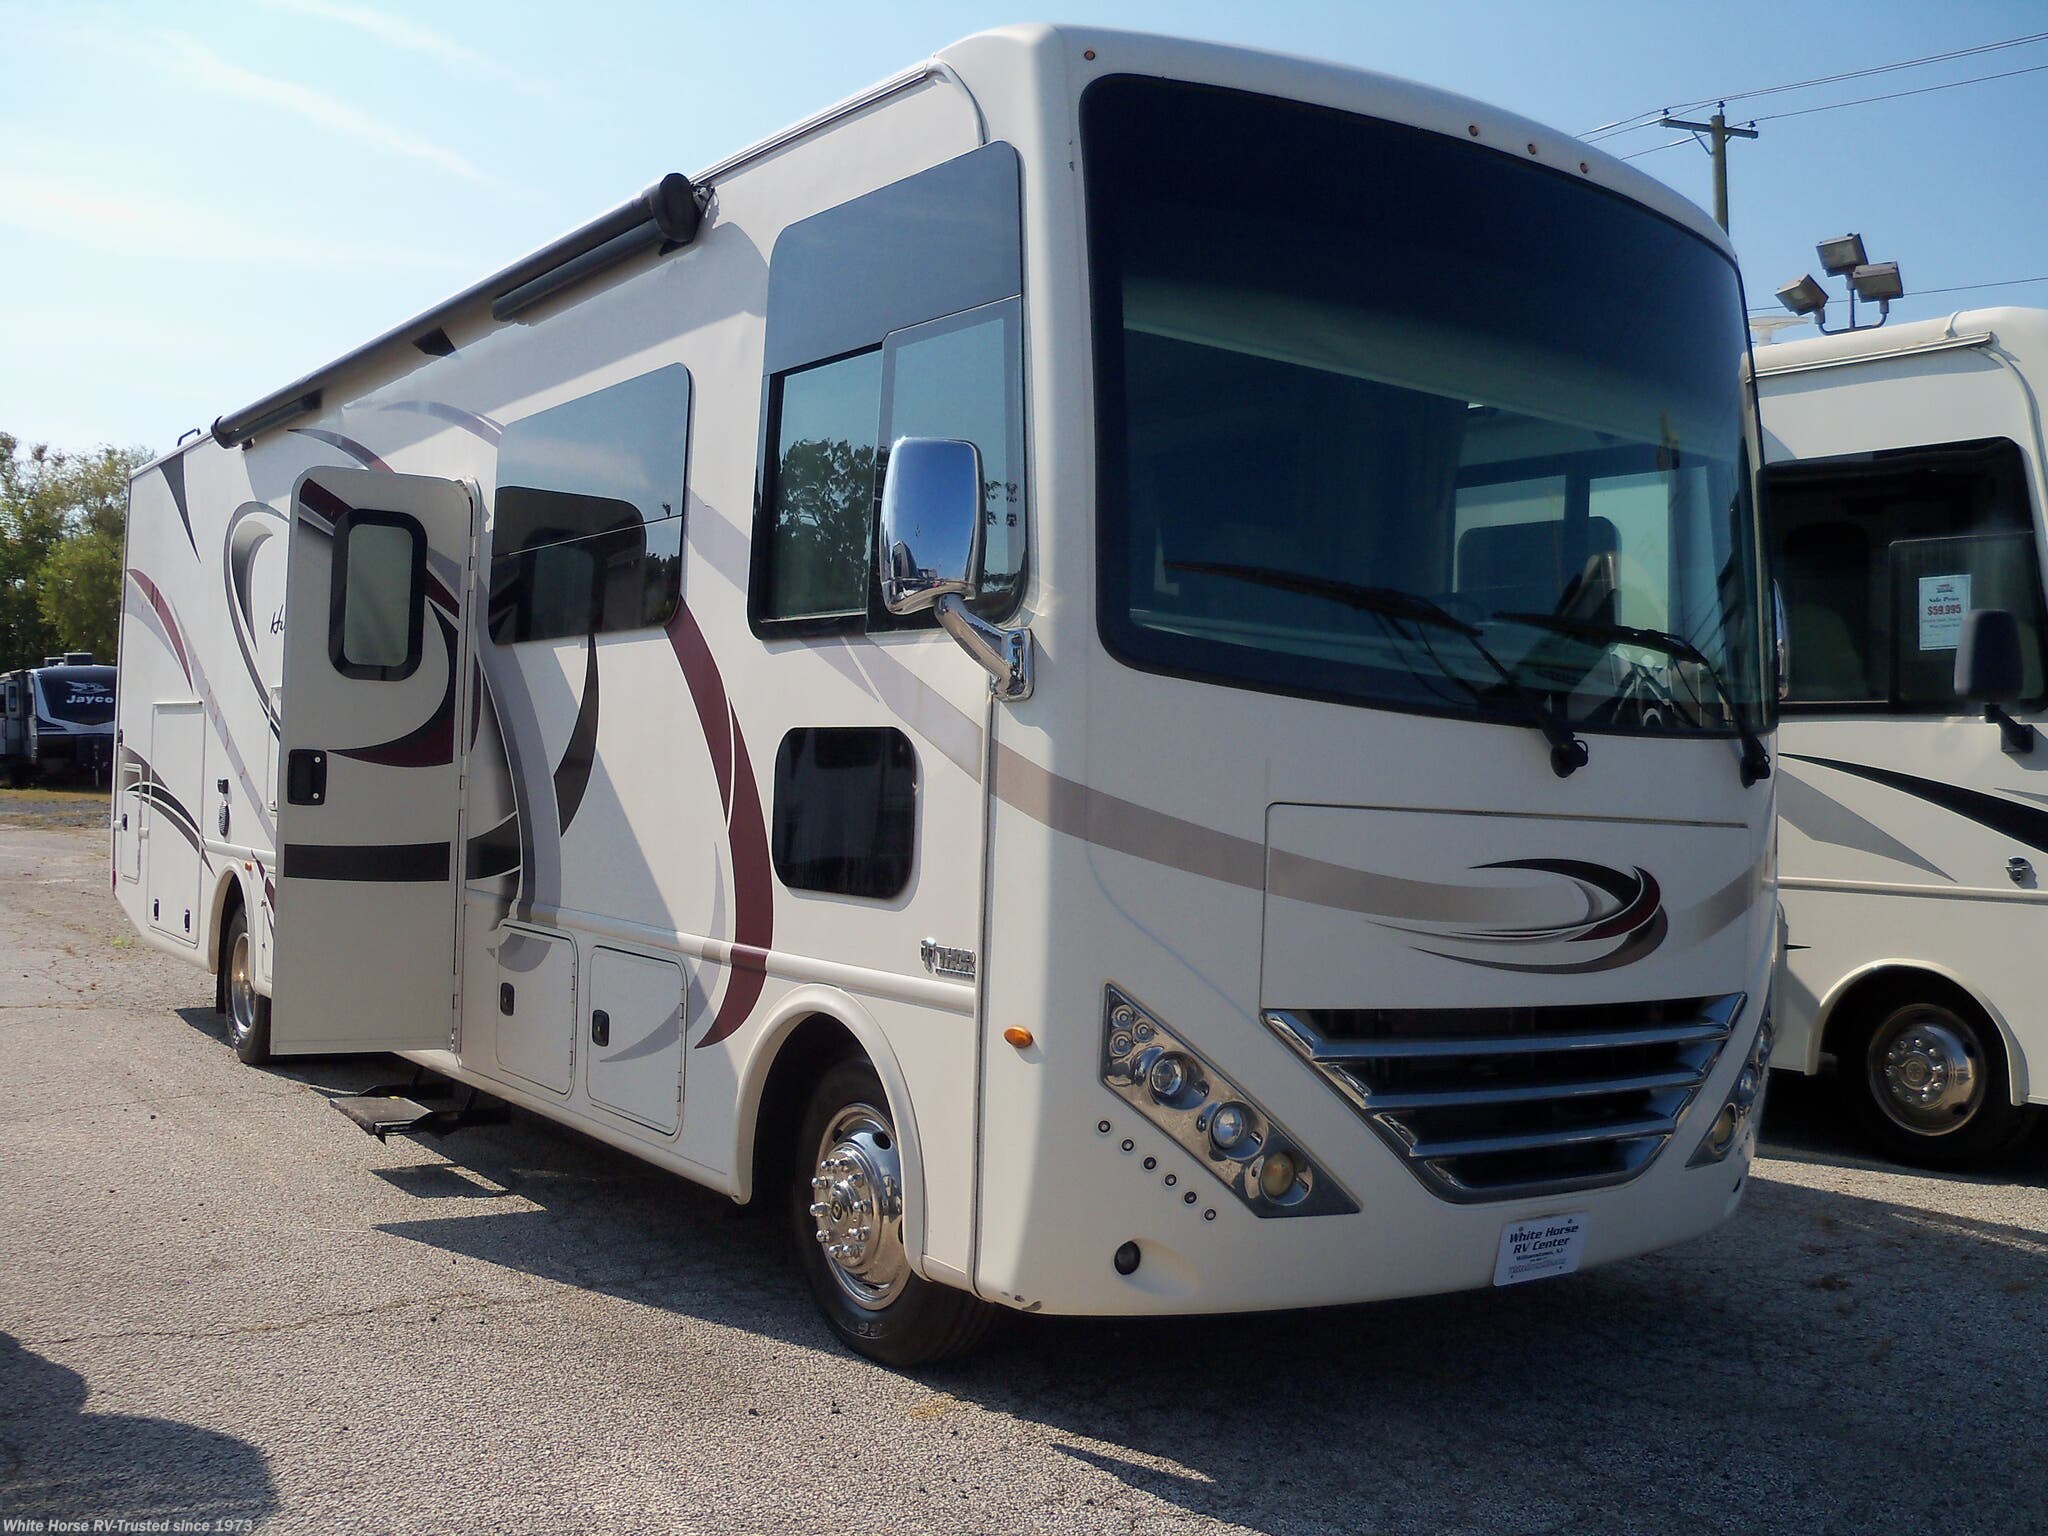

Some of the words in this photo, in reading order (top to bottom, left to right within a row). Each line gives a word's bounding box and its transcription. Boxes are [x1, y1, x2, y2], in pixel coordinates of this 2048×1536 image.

[66, 695, 114, 705] Jayco
[1509, 1230, 1543, 1244] White
[1545, 1225, 1579, 1238] Horse
[1513, 1242, 1531, 1255] RV
[1532, 1237, 1571, 1251] Center
